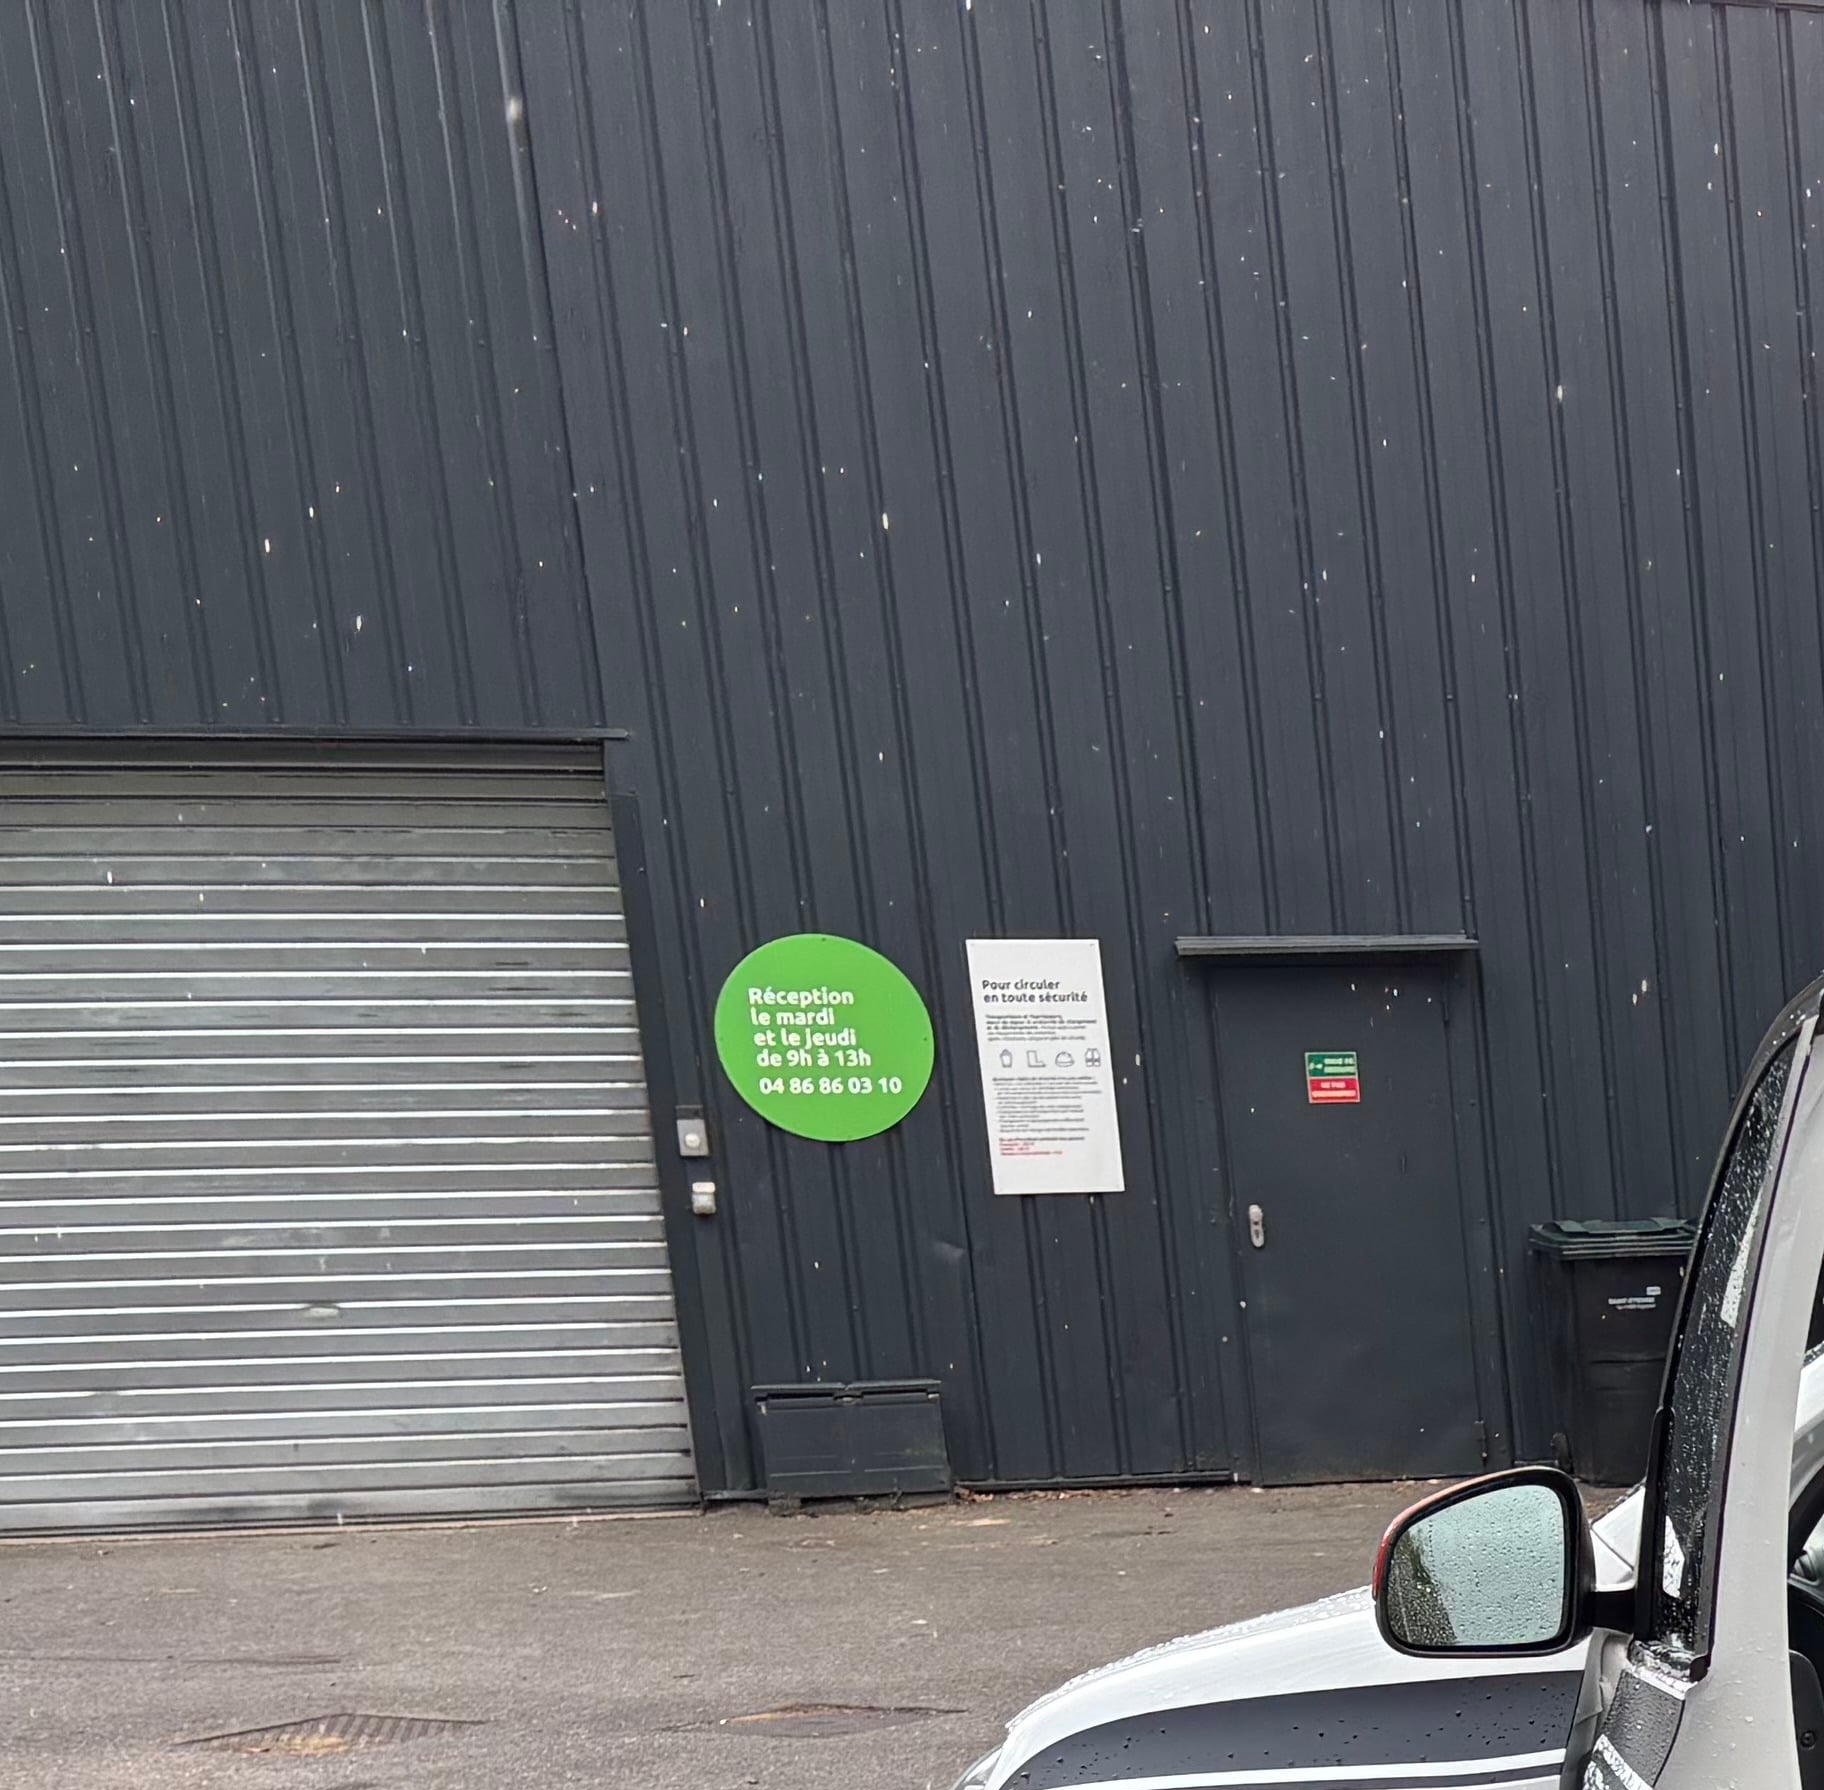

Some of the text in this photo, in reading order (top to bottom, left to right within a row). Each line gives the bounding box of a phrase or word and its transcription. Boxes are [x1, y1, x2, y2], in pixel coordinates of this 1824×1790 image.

[982, 979, 1060, 991] Pour circuler
[748, 986, 854, 1008] Réception
[983, 991, 1088, 1003] en toute sécurité
[750, 1007, 835, 1026] le mardi
[753, 1028, 857, 1050] et le jeudi
[756, 1048, 872, 1067] de 9h à 13h
[759, 1076, 902, 1095] 04 86 86 03 10
